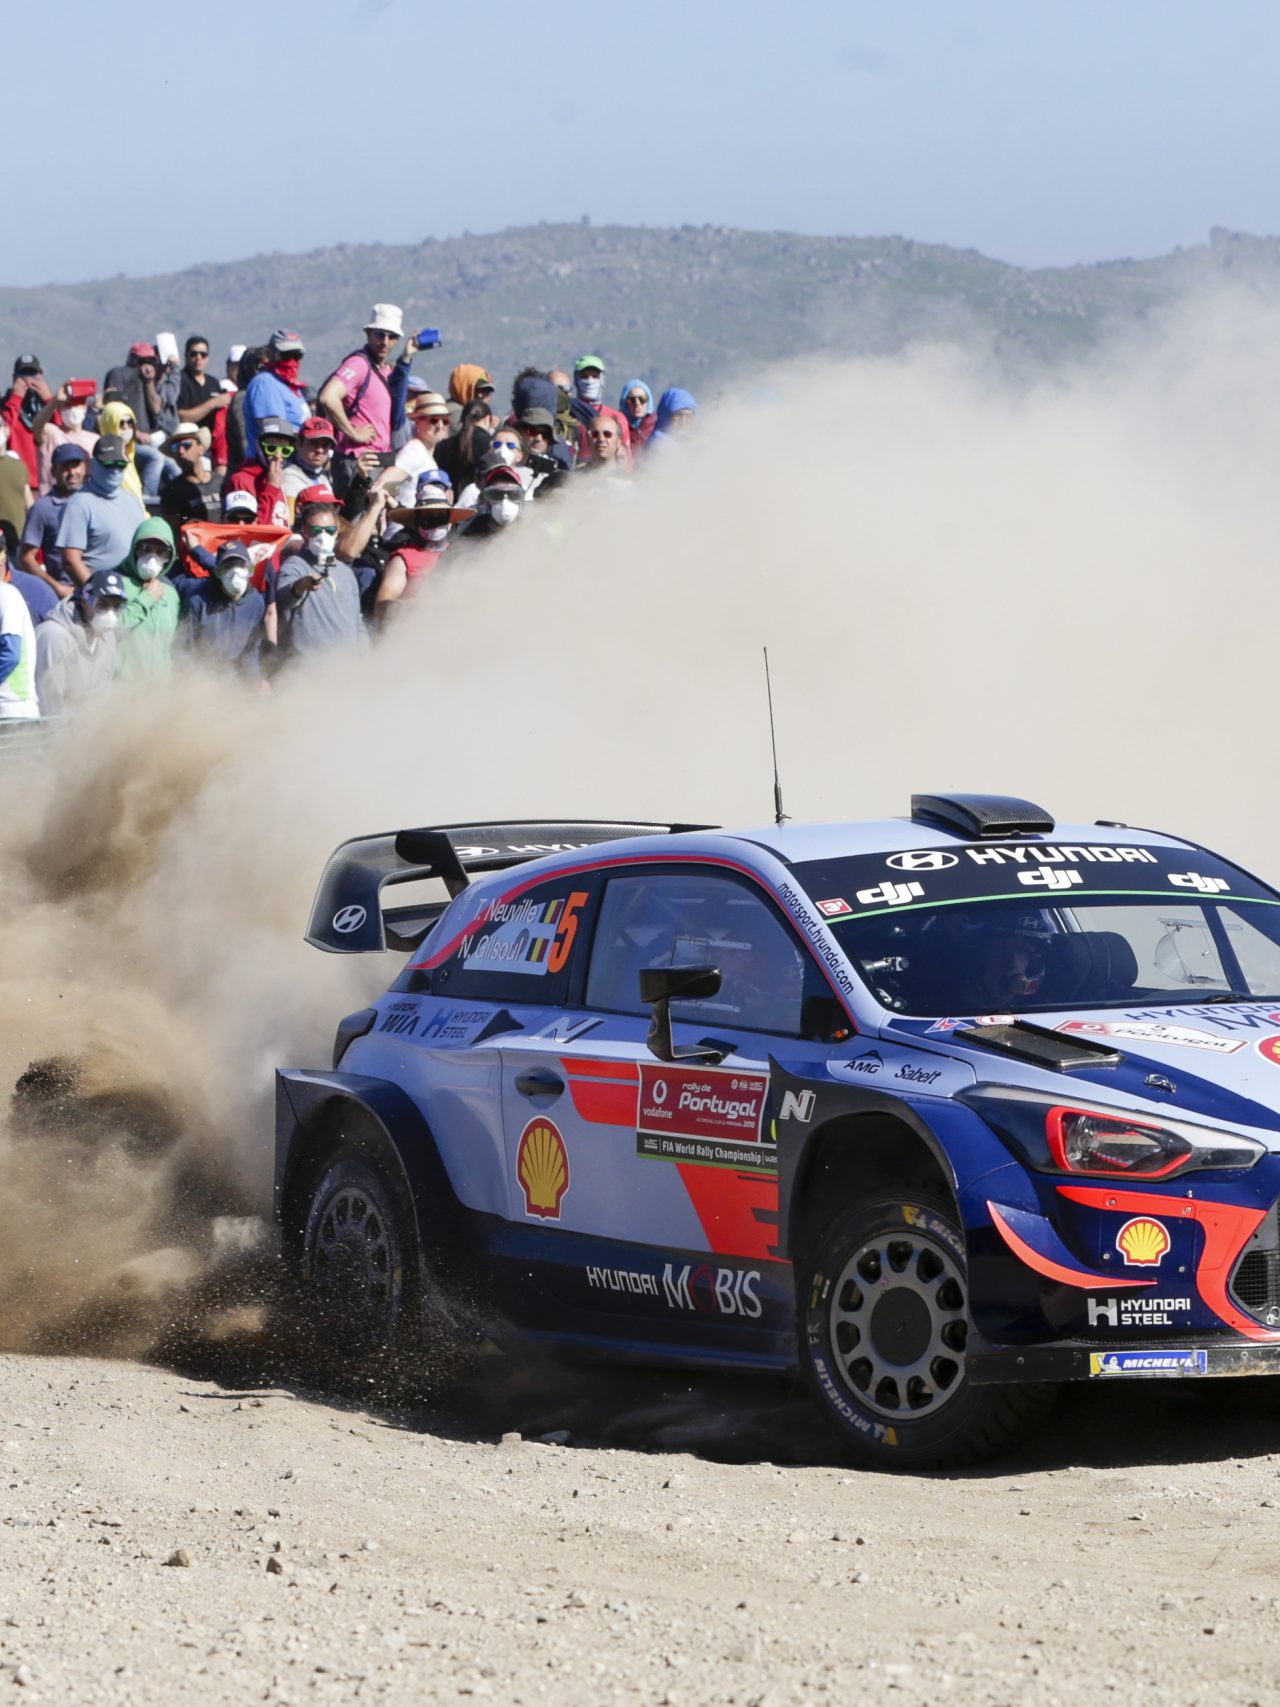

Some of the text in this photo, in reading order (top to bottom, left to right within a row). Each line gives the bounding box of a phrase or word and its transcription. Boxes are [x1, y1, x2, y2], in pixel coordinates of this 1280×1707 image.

[965, 847, 1158, 865] HYUNDAI
[474, 899, 488, 921] T.
[484, 898, 538, 923] Neuville
[547, 892, 589, 973] 5
[778, 882, 854, 995] motorsport.hyundai.com
[457, 934, 525, 961] N. Gilsoul
[451, 1011, 493, 1024] HYUNDAI
[439, 1026, 467, 1039] STEEL
[844, 1060, 880, 1074] AMG
[895, 1064, 942, 1085] Sabelt
[682, 1082, 712, 1093] rally de
[643, 1107, 673, 1119] vodafone
[678, 1092, 756, 1120] Portugal
[662, 1141, 674, 1152] FIA
[675, 1142, 695, 1155] World
[696, 1144, 713, 1160] Rally
[715, 1147, 761, 1165] Championship
[586, 1263, 762, 1318] HYUNDAI MOBIS
[1120, 1298, 1191, 1311] HYUNDAI
[1121, 1313, 1172, 1325] STEEL
[814, 1358, 872, 1434] MICHELIN
